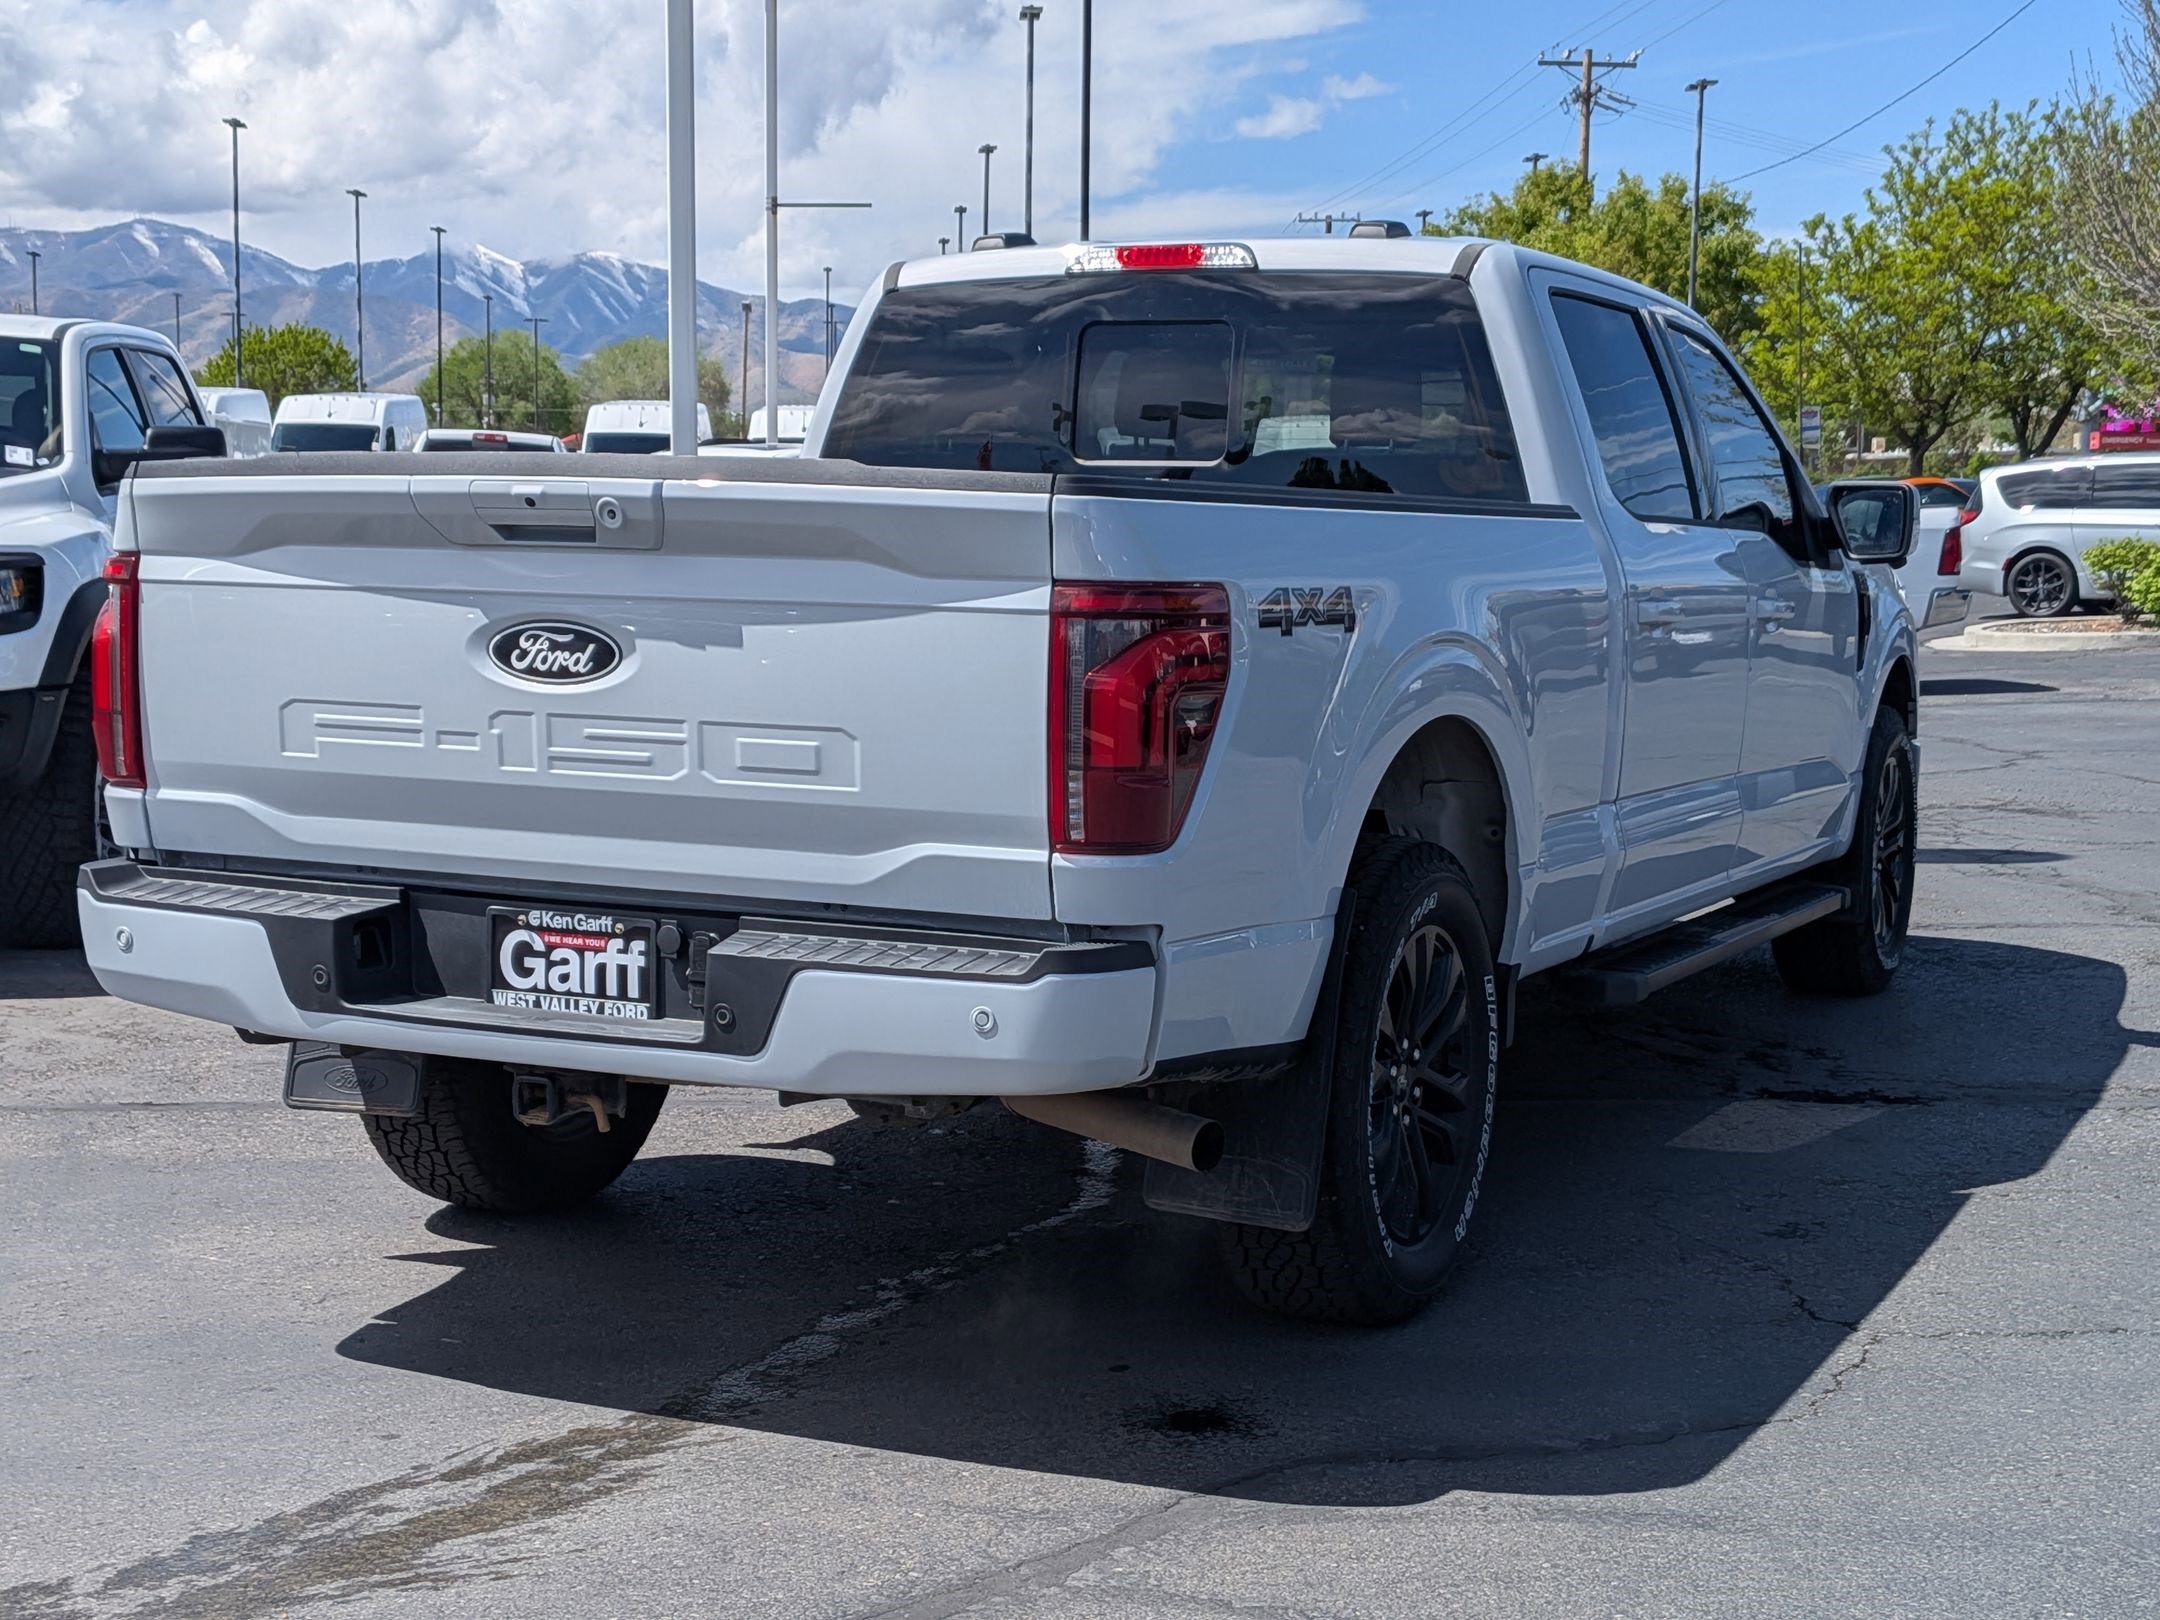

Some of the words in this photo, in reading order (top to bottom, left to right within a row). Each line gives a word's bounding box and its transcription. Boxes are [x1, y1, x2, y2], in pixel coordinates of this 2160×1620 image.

[511, 630, 596, 673] Ford
[279, 698, 861, 792] F-150
[542, 911, 573, 929] Ken
[574, 913, 613, 933] Garff
[550, 935, 561, 943] WE
[563, 936, 584, 945] HEAR
[500, 929, 646, 998] Garff
[492, 991, 536, 1009] WEST
[540, 995, 601, 1015] VALLEY
[604, 1001, 649, 1020] FORD
